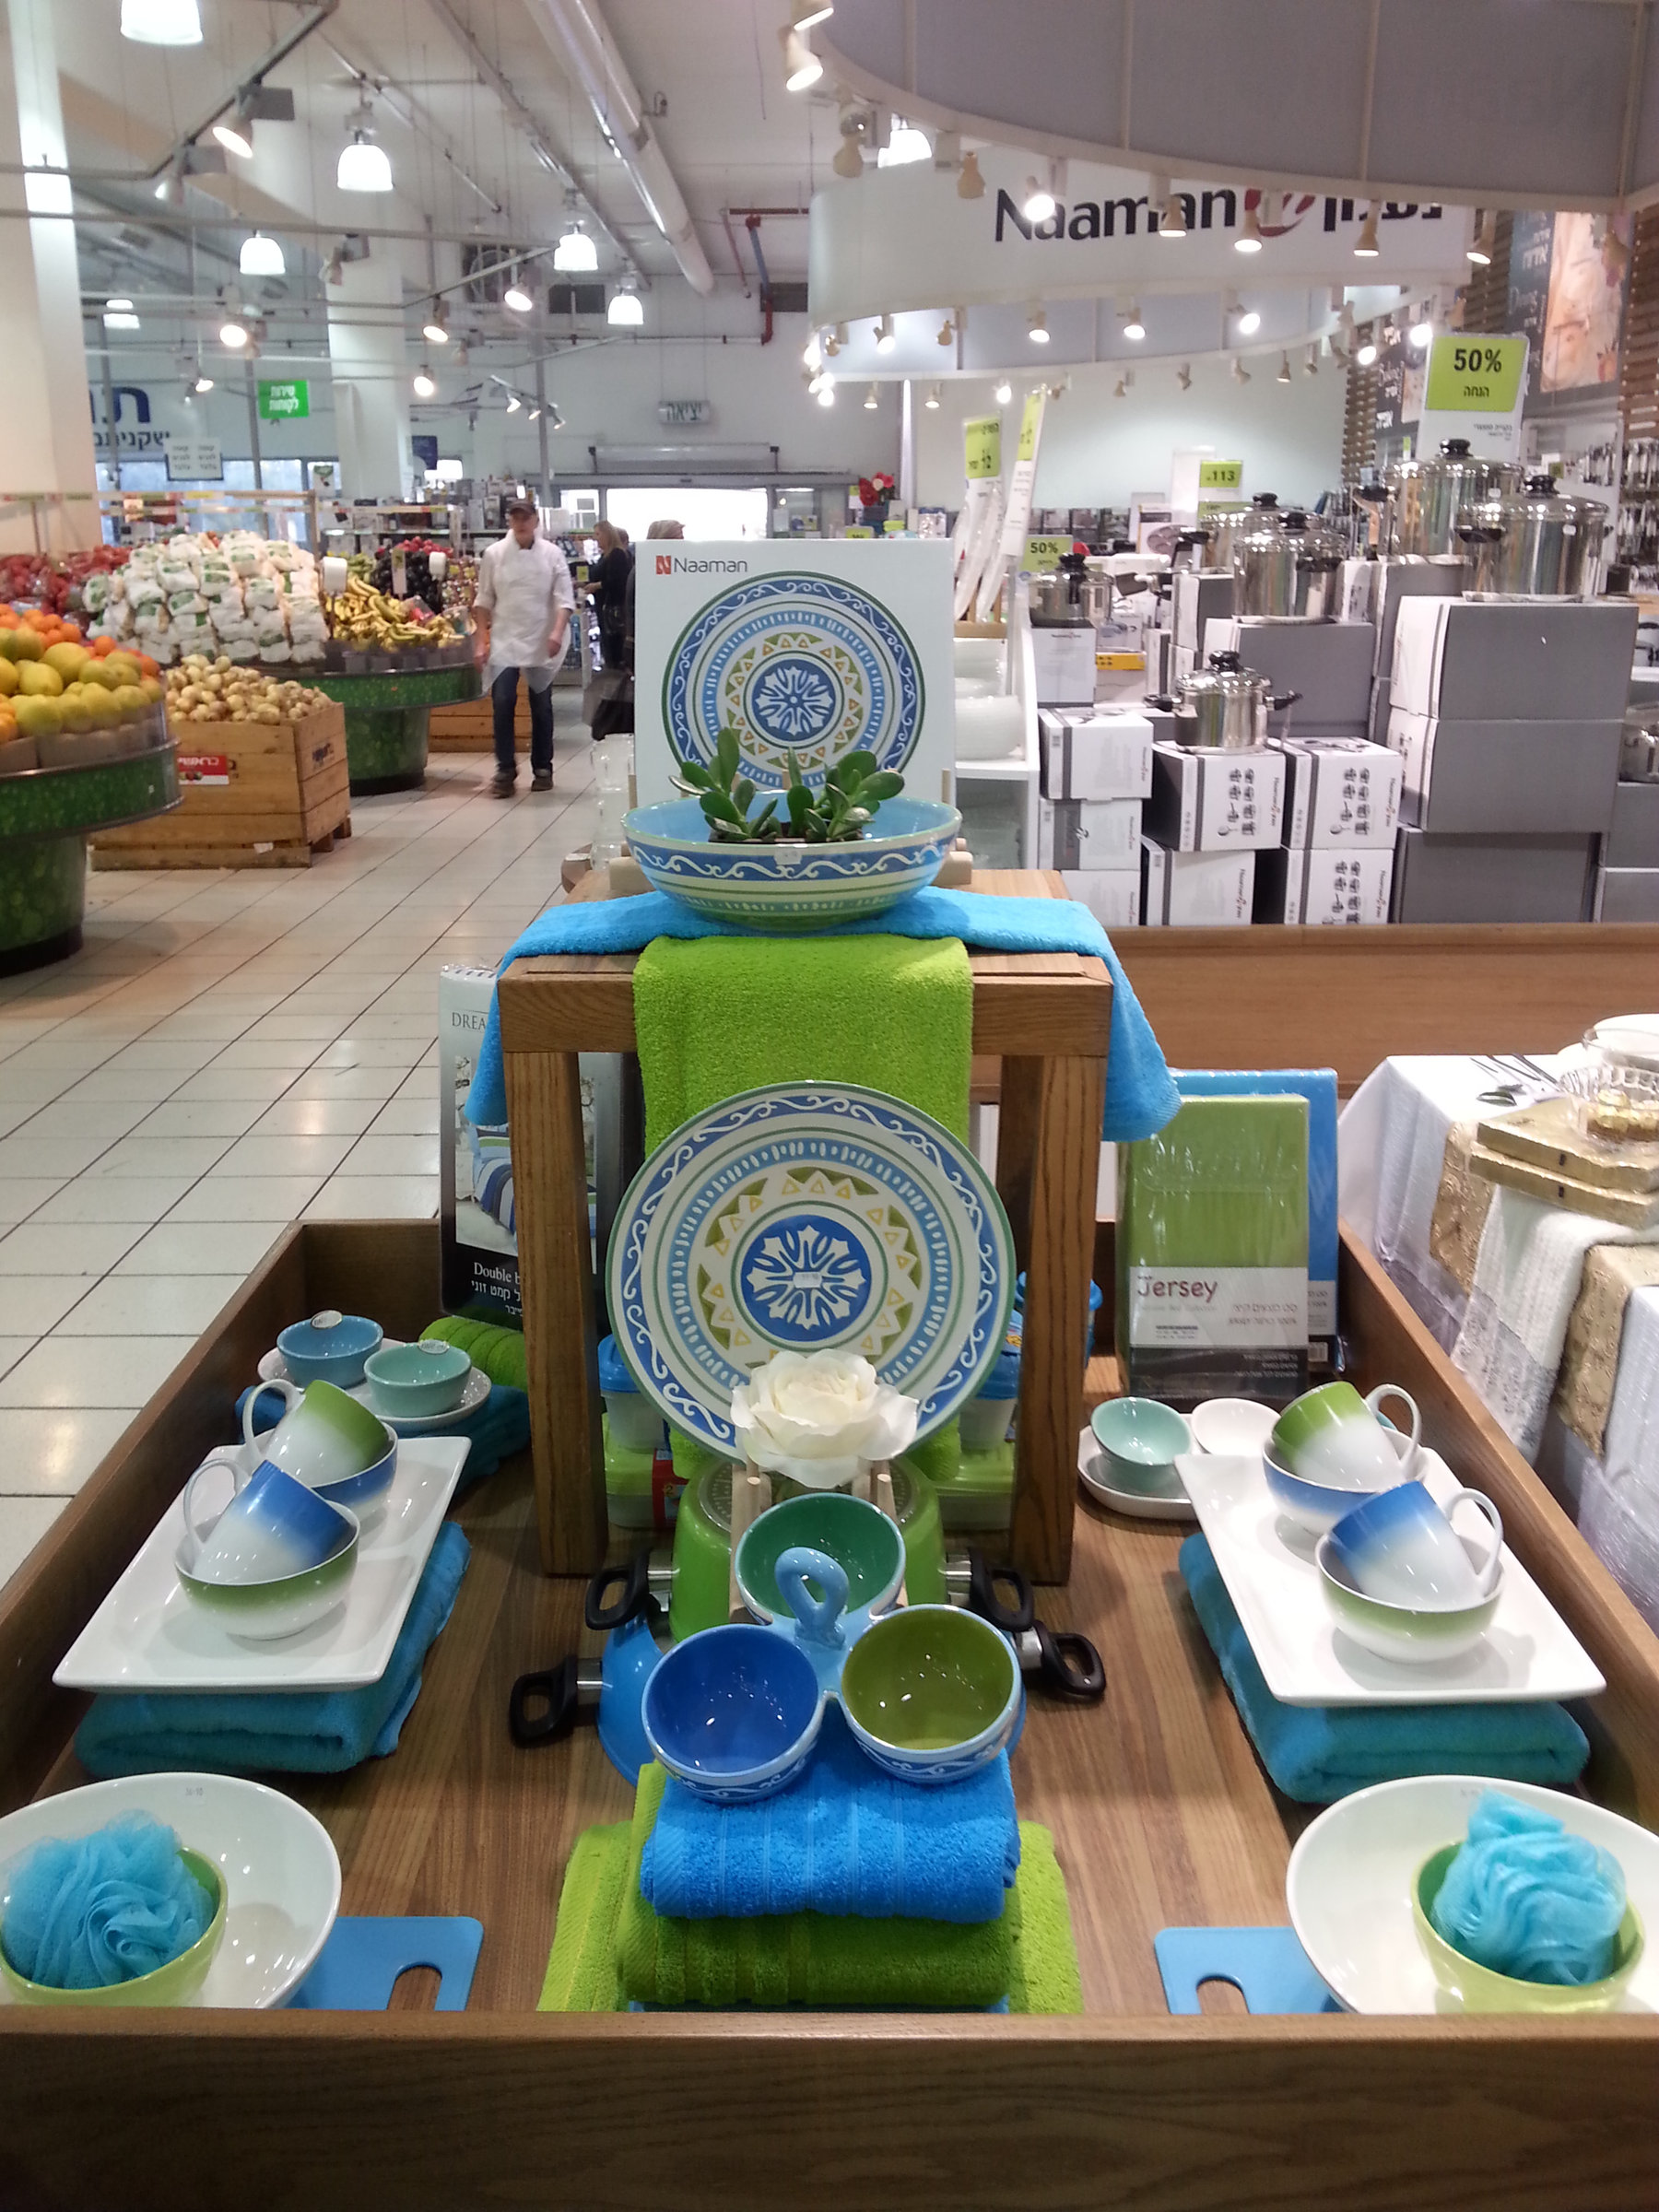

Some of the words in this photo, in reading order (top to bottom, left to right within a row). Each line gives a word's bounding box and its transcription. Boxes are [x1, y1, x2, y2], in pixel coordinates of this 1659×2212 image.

[1453, 348, 1502, 372] 50%
[1464, 385, 1490, 398] הנחה
[666, 402, 702, 421] יציאה
[1030, 541, 1059, 554] 50%
[674, 558, 747, 573] Naaman
[474, 1262, 512, 1283] Double
[490, 1285, 511, 1301] קמט
[1137, 1276, 1218, 1303] Jersey
